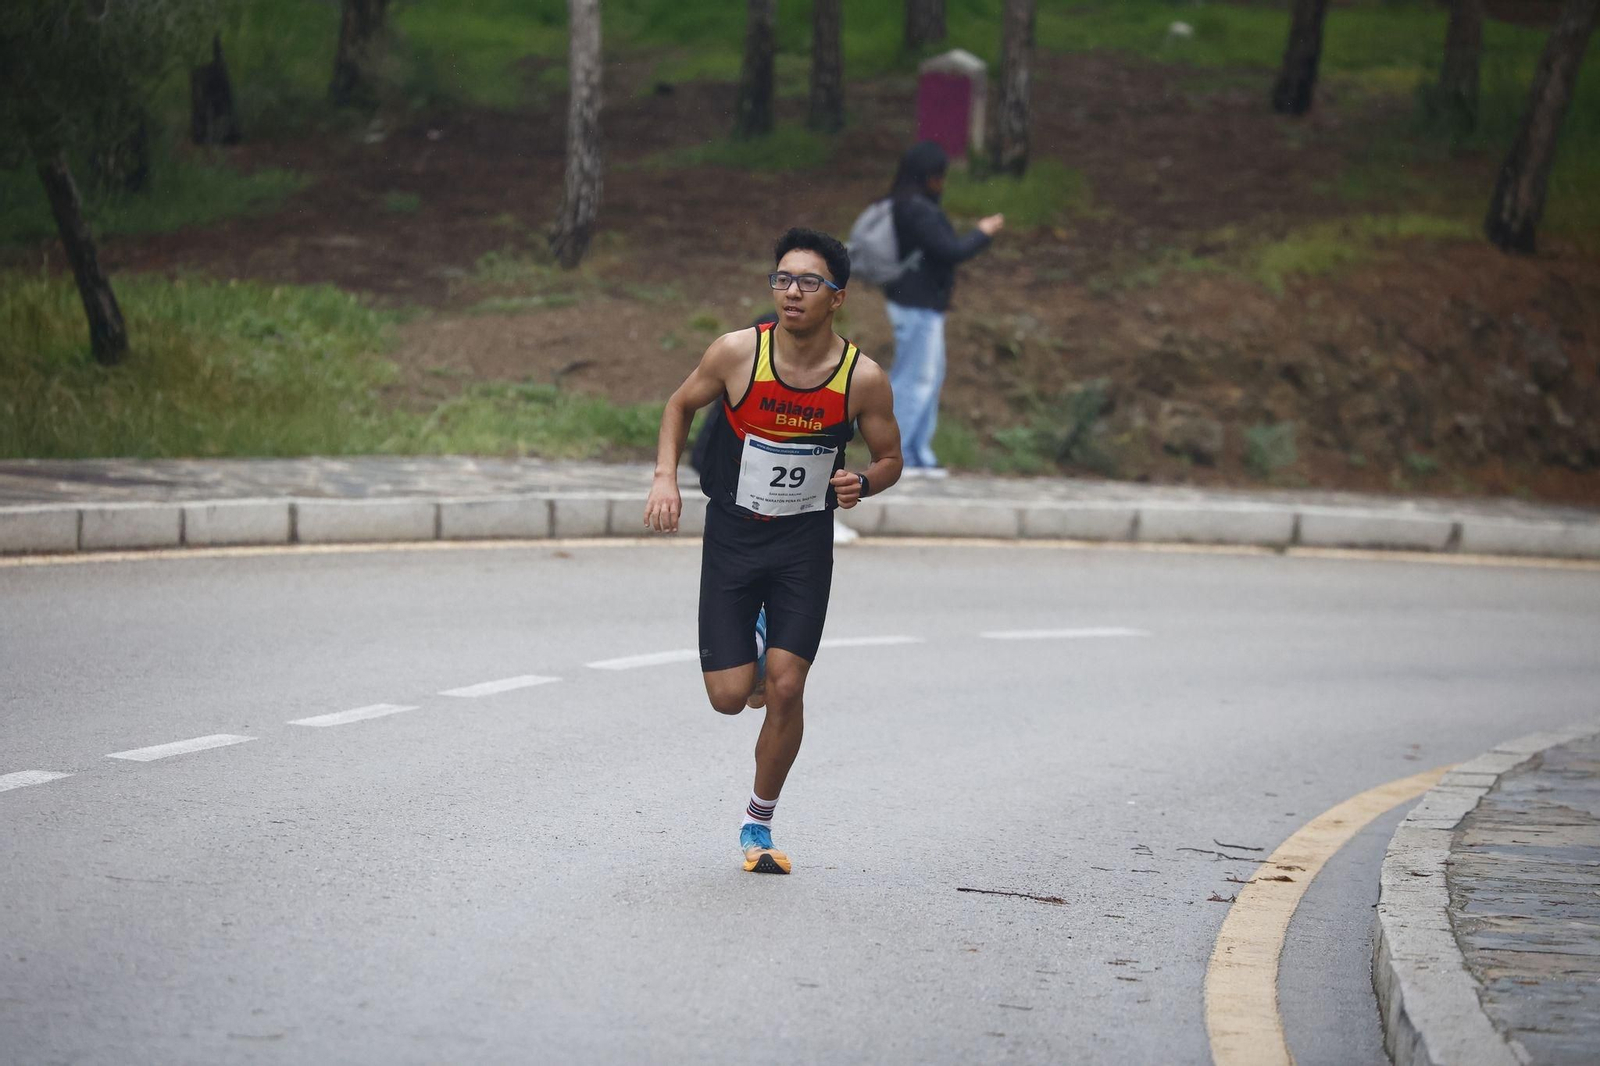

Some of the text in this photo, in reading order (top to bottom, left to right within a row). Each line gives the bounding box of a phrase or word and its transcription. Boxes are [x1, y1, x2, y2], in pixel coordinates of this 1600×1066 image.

[759, 397, 825, 419] Málaga
[775, 413, 823, 431] Bahía
[769, 466, 807, 489] 29
